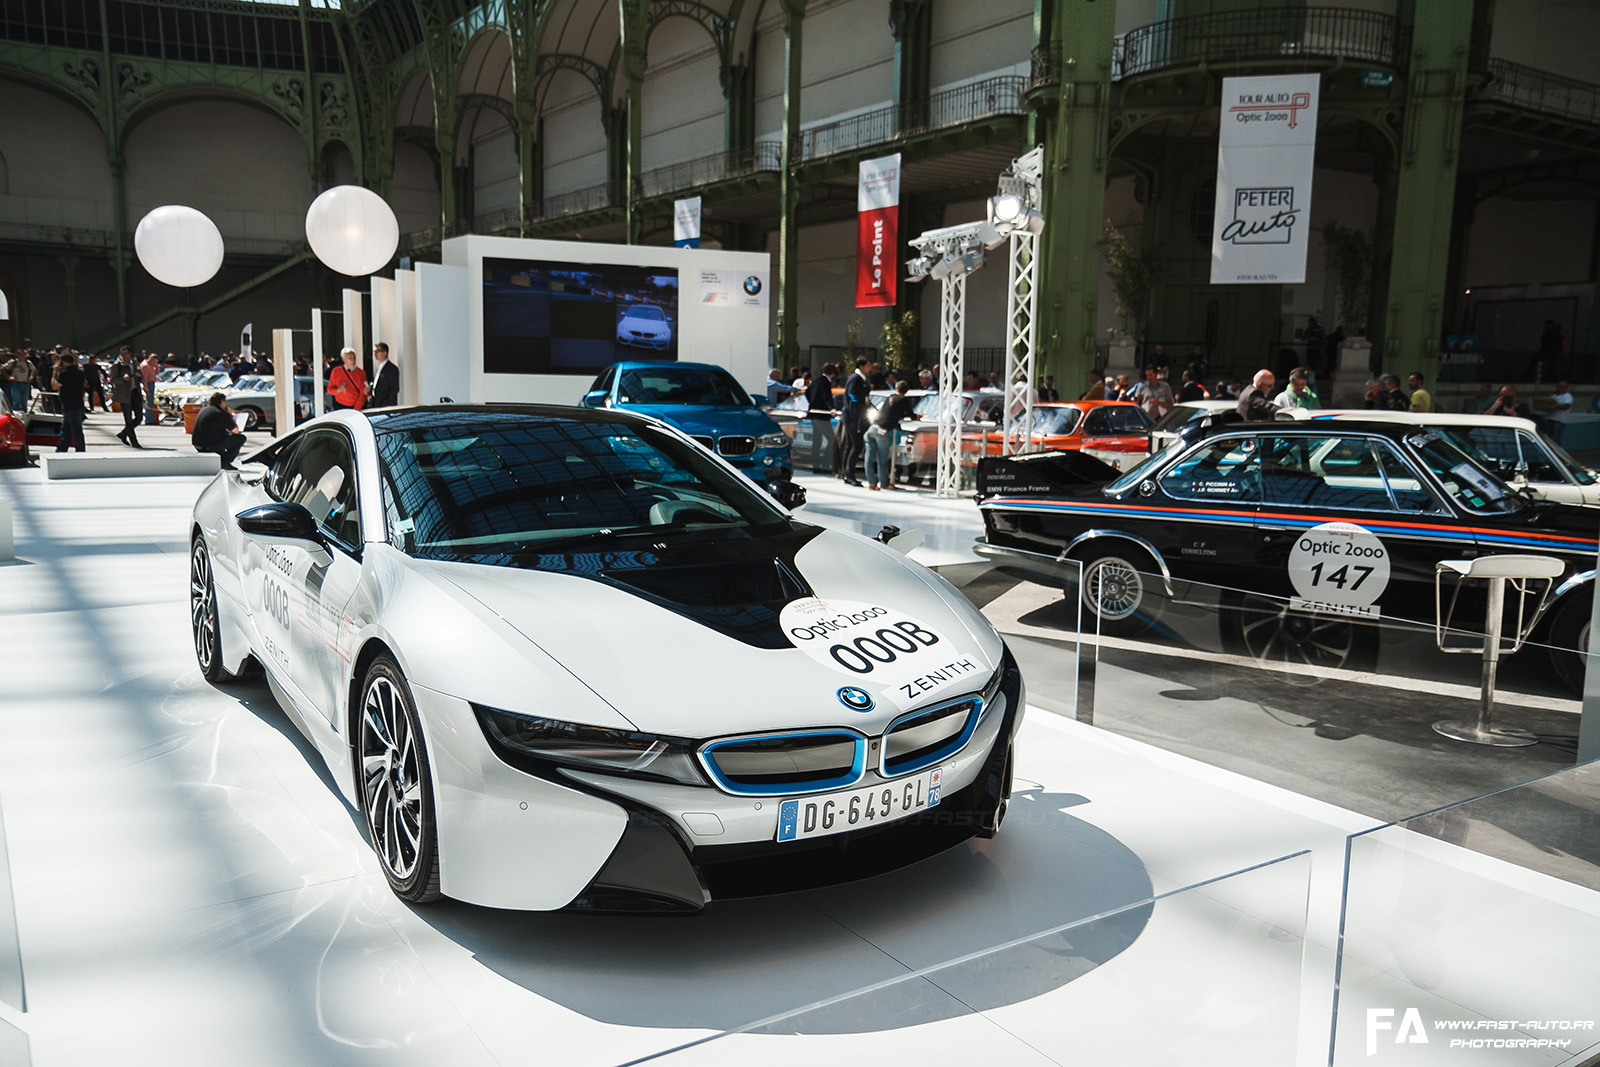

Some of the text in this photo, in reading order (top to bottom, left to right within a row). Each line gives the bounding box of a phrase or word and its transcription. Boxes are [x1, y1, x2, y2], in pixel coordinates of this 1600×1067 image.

[1239, 92, 1290, 104] TOUR AUTO
[1236, 112, 1288, 123] Optic 2000
[1237, 190, 1290, 207] PETER
[1221, 209, 1302, 241] auto
[873, 219, 884, 266] Point
[872, 269, 882, 289] Le
[1003, 485, 1028, 493] Finance
[1028, 484, 1050, 492] France
[1299, 538, 1384, 559] Optic 2000
[1310, 562, 1375, 591] 147
[263, 573, 290, 631] 000B
[1300, 600, 1371, 616] ZENITH
[791, 606, 888, 640] Optic 2000
[264, 636, 290, 669] ZENITH
[829, 621, 940, 674] 000B
[899, 658, 977, 699] ZENITH
[803, 779, 925, 833] DG-649-GL
[928, 787, 941, 804] 78
[784, 824, 792, 834] F
